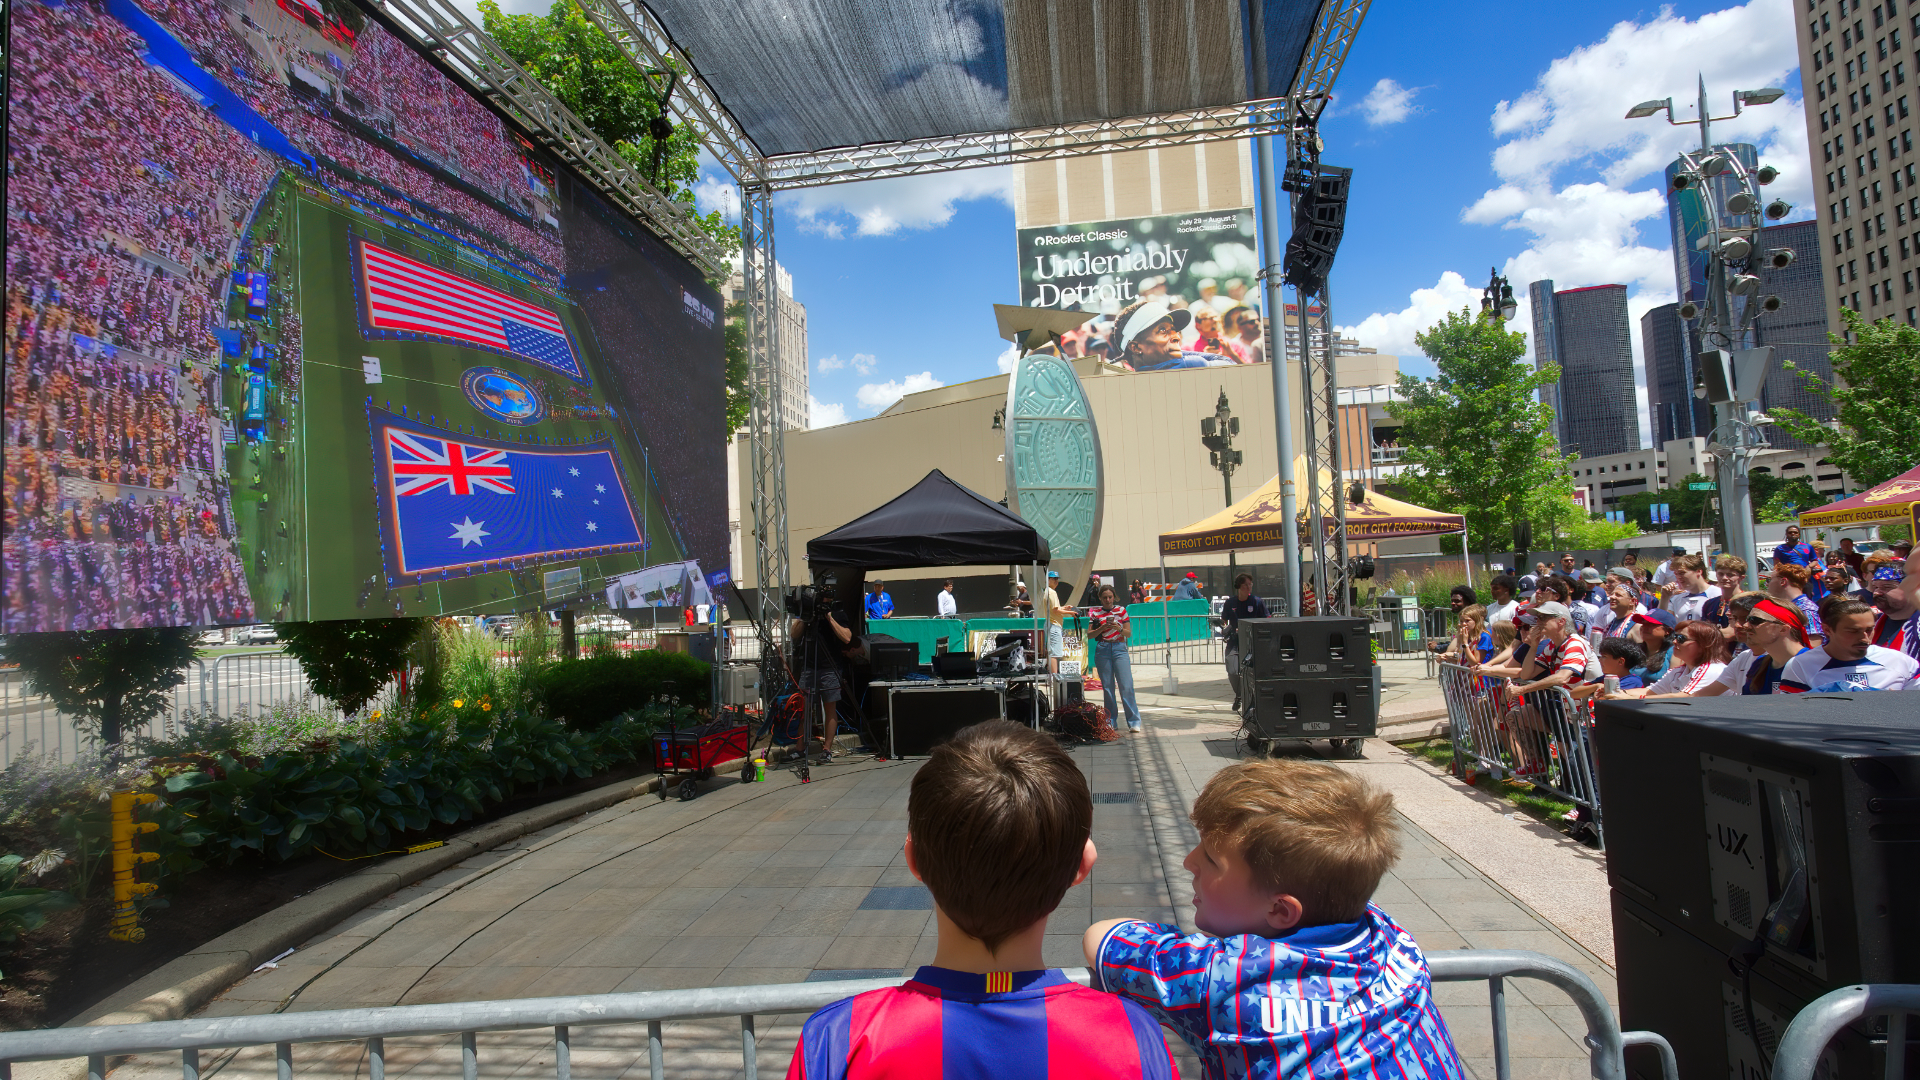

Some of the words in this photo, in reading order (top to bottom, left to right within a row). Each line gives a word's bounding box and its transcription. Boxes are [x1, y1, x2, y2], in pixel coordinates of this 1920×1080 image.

[1046, 232, 1085, 246] Rocket
[1086, 229, 1128, 242] Classic
[1177, 223, 1237, 233] RocketClassic.com
[1035, 244, 1188, 279] Undeniably
[1038, 278, 1140, 308] Detroit.
[702, 304, 715, 323] FOX
[1803, 516, 1834, 526] DETROIT
[1836, 514, 1853, 522] CITY
[1856, 509, 1901, 520] FOOTBALL
[1371, 523, 1392, 534] CITY
[1394, 522, 1436, 532] FOOTBALL
[1164, 538, 1202, 550] DETROIT
[1205, 535, 1226, 546] CITY
[1229, 530, 1282, 543] FOOTBALL
[1717, 823, 1754, 870] UX
